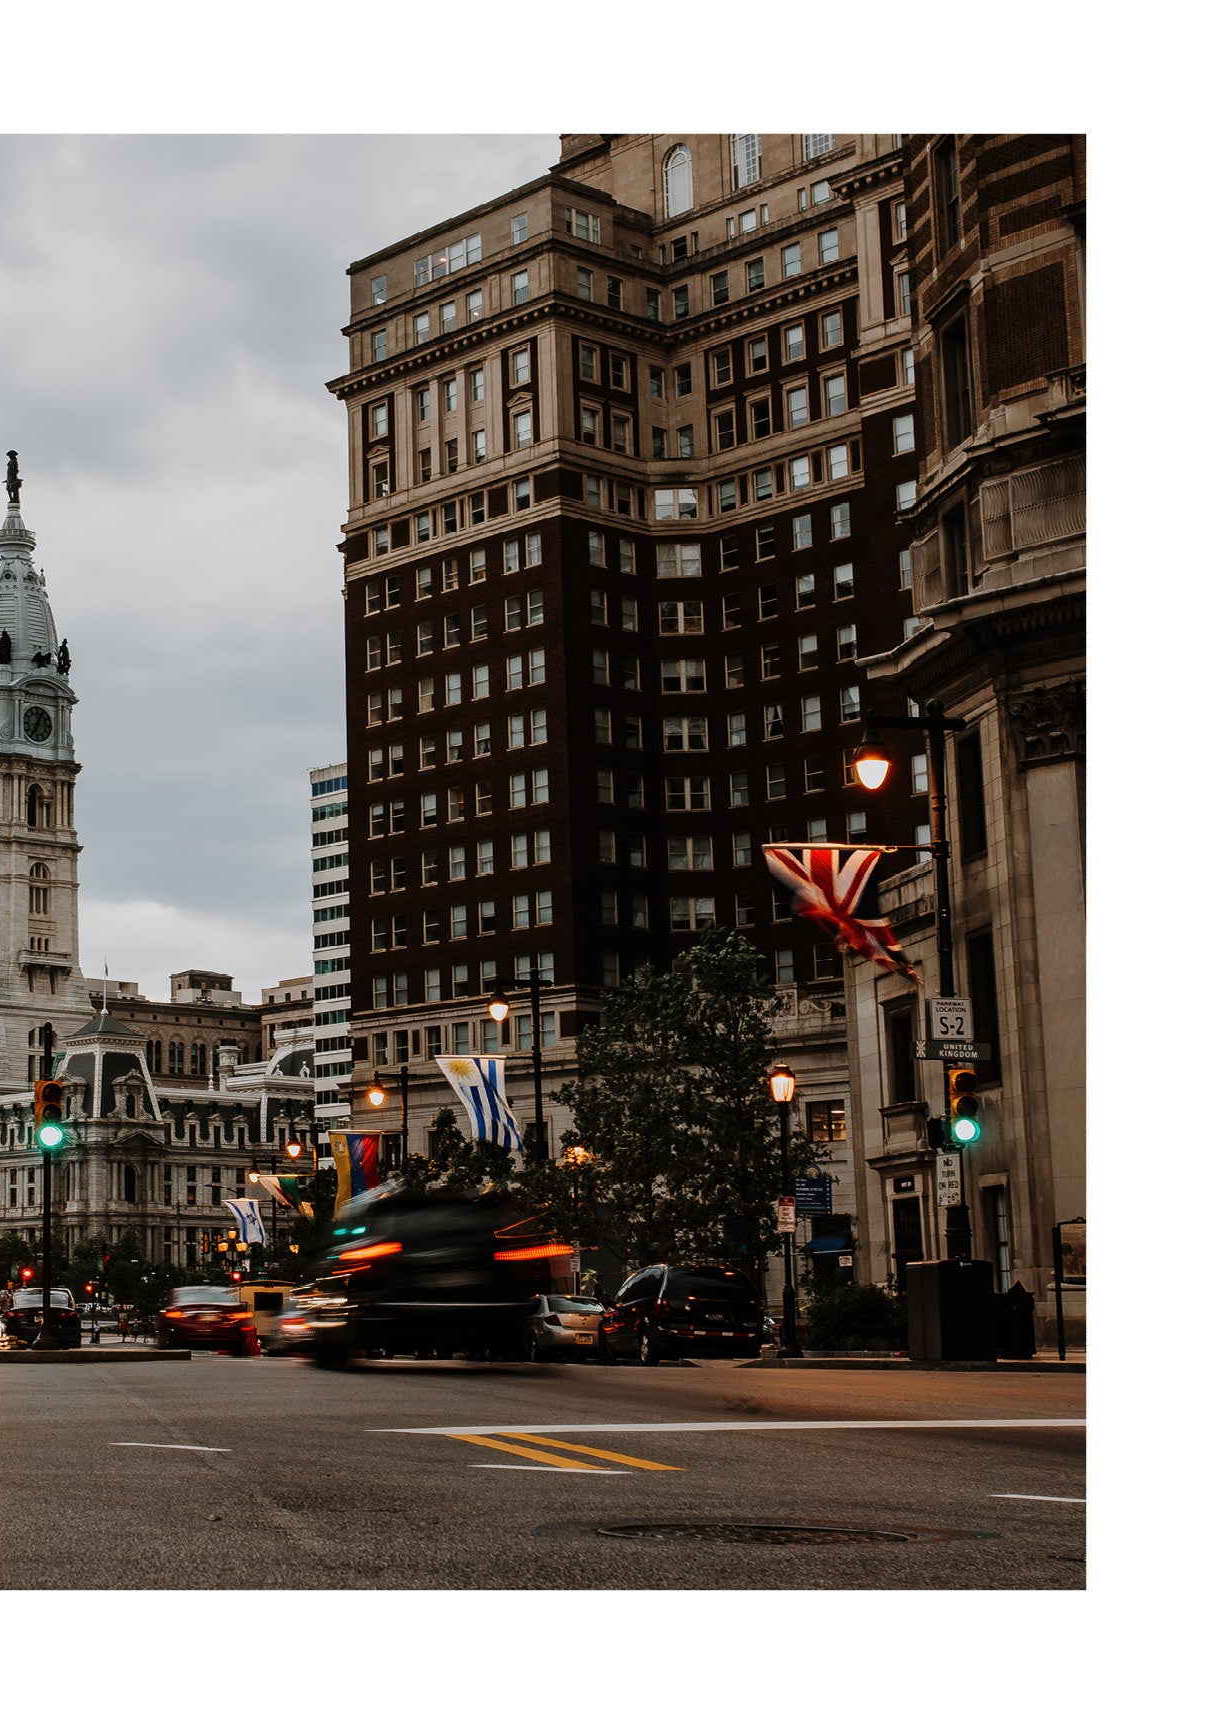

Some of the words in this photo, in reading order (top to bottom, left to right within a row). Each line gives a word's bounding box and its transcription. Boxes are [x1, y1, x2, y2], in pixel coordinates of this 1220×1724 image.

[940, 1016, 965, 1036] S-2
[939, 1050, 978, 1058] KINGDOM
[943, 1158, 953, 1167] NO
[941, 1170, 956, 1178] TURN
[939, 1182, 946, 1190] ON
[948, 1180, 959, 1189] RED
